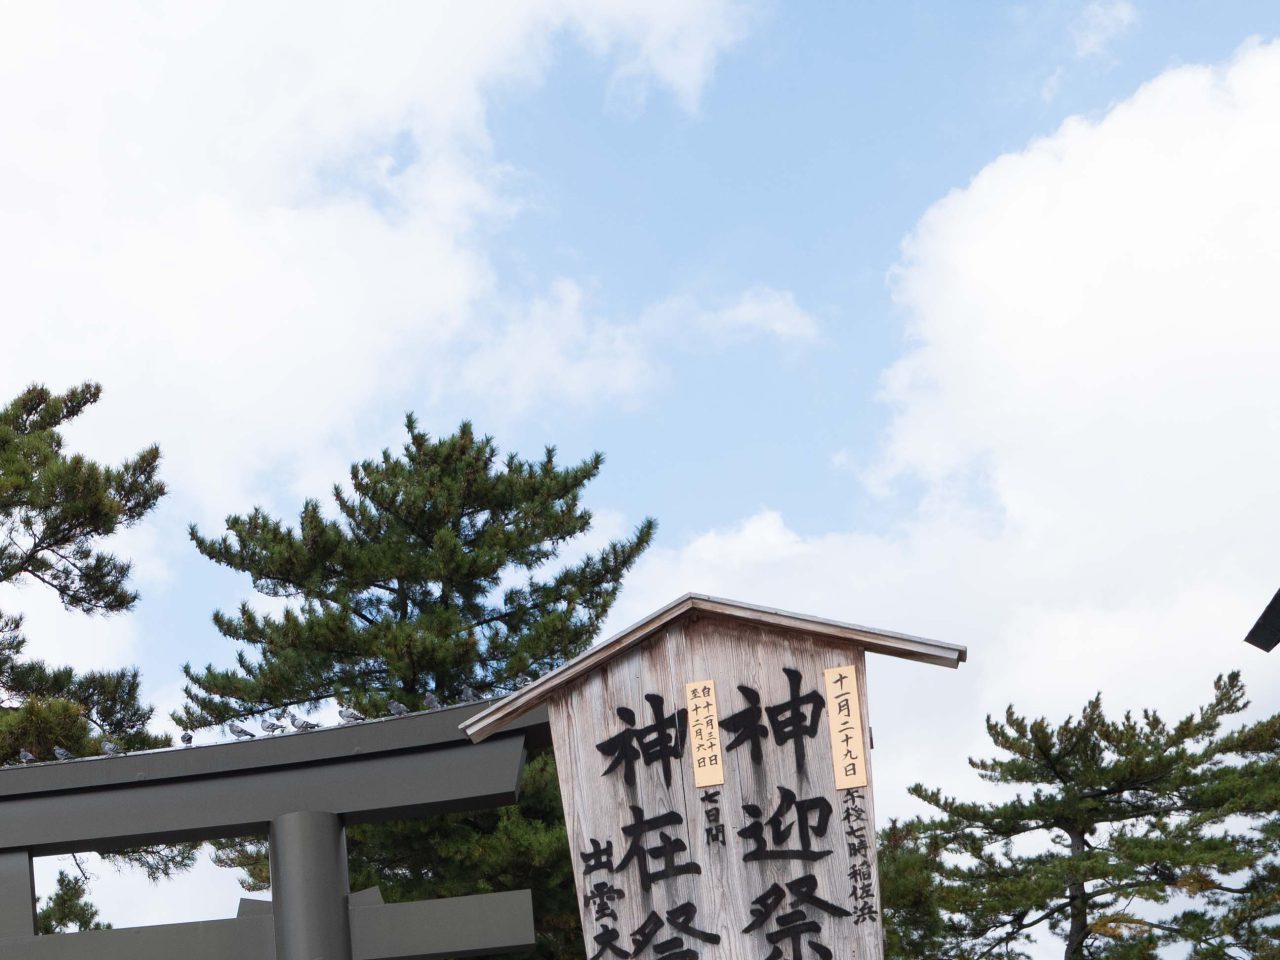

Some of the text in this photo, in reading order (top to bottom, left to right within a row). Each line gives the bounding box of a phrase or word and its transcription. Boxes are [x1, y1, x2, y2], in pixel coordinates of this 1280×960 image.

[690, 688, 707, 768] 至十二月六日
[701, 685, 718, 766] 自十一月三十日
[832, 672, 858, 777] 十一月二十九日
[700, 790, 726, 846] 七日間
